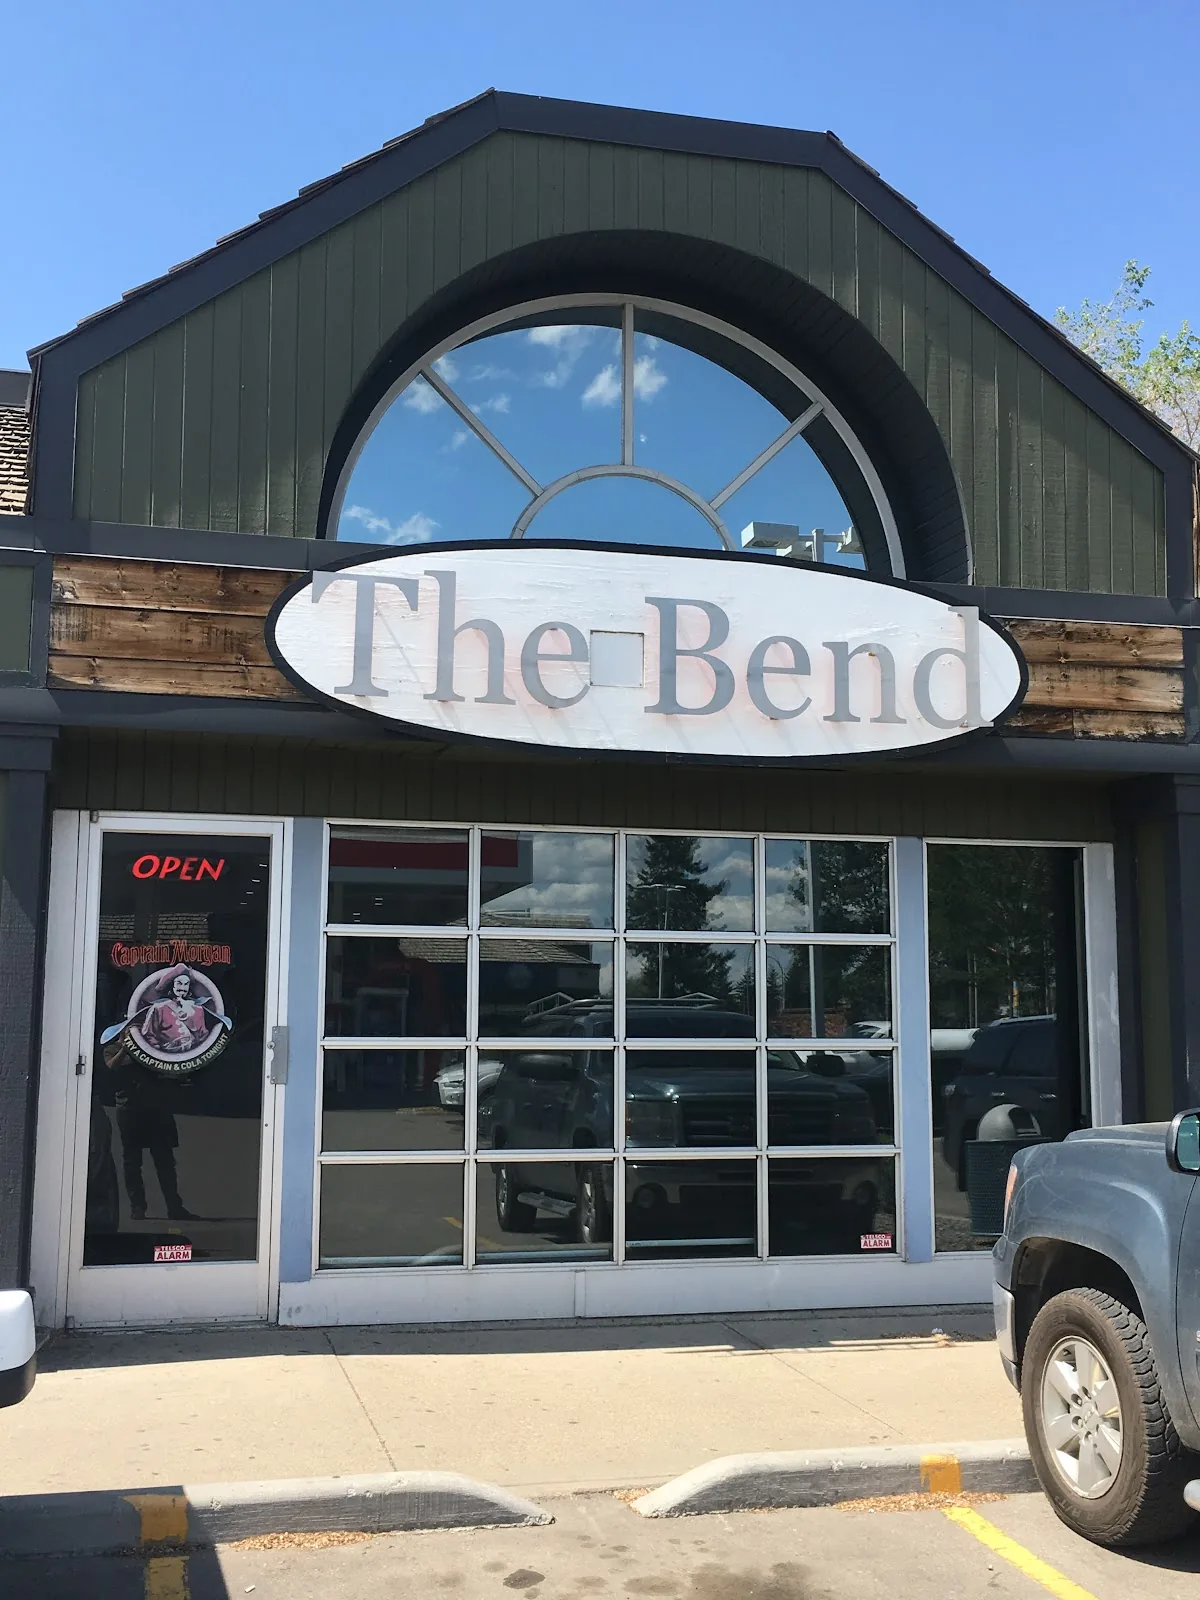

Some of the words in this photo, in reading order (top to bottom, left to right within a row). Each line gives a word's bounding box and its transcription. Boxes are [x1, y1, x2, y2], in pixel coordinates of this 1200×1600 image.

[312, 570, 591, 709] The
[643, 596, 994, 729] Bend
[132, 854, 225, 881] OPEN
[111, 940, 170, 967] Captain
[169, 939, 231, 966] Morgan
[123, 1035, 136, 1051] TRY
[139, 1052, 172, 1071] CAPTAIN
[173, 1063, 180, 1071] &
[181, 1059, 202, 1070] COLA
[202, 1033, 229, 1062] TONIGHT
[157, 1251, 190, 1260] ALARM
[863, 1239, 890, 1247] ALARM
